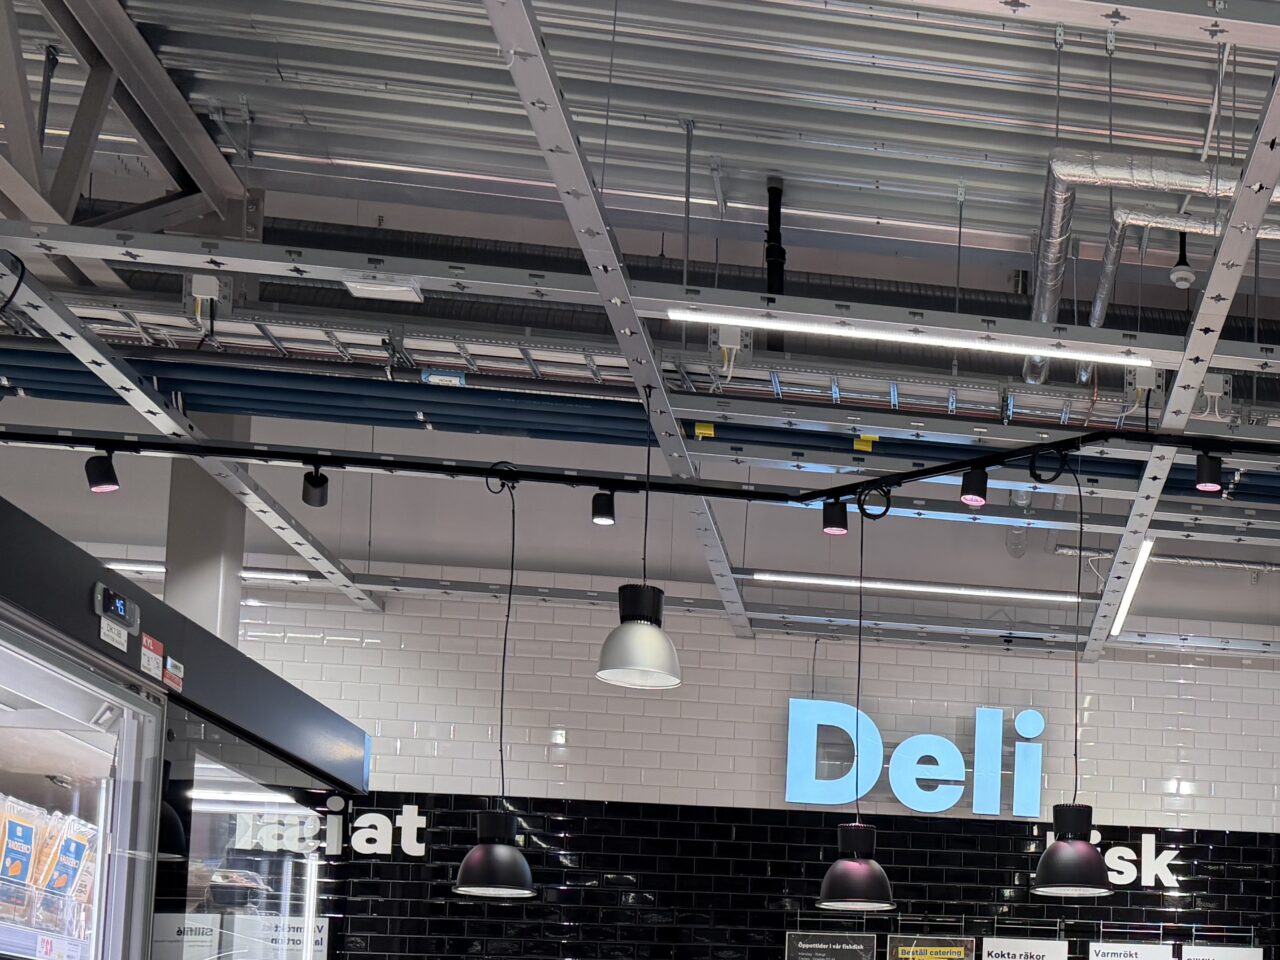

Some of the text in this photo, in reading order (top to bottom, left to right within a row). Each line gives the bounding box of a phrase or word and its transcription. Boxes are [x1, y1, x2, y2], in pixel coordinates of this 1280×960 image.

[785, 699, 1045, 818] Deli
[929, 949, 962, 957] catering
[987, 950, 1046, 960] Kokta räkor
[1094, 950, 1138, 959] Varmrökt
